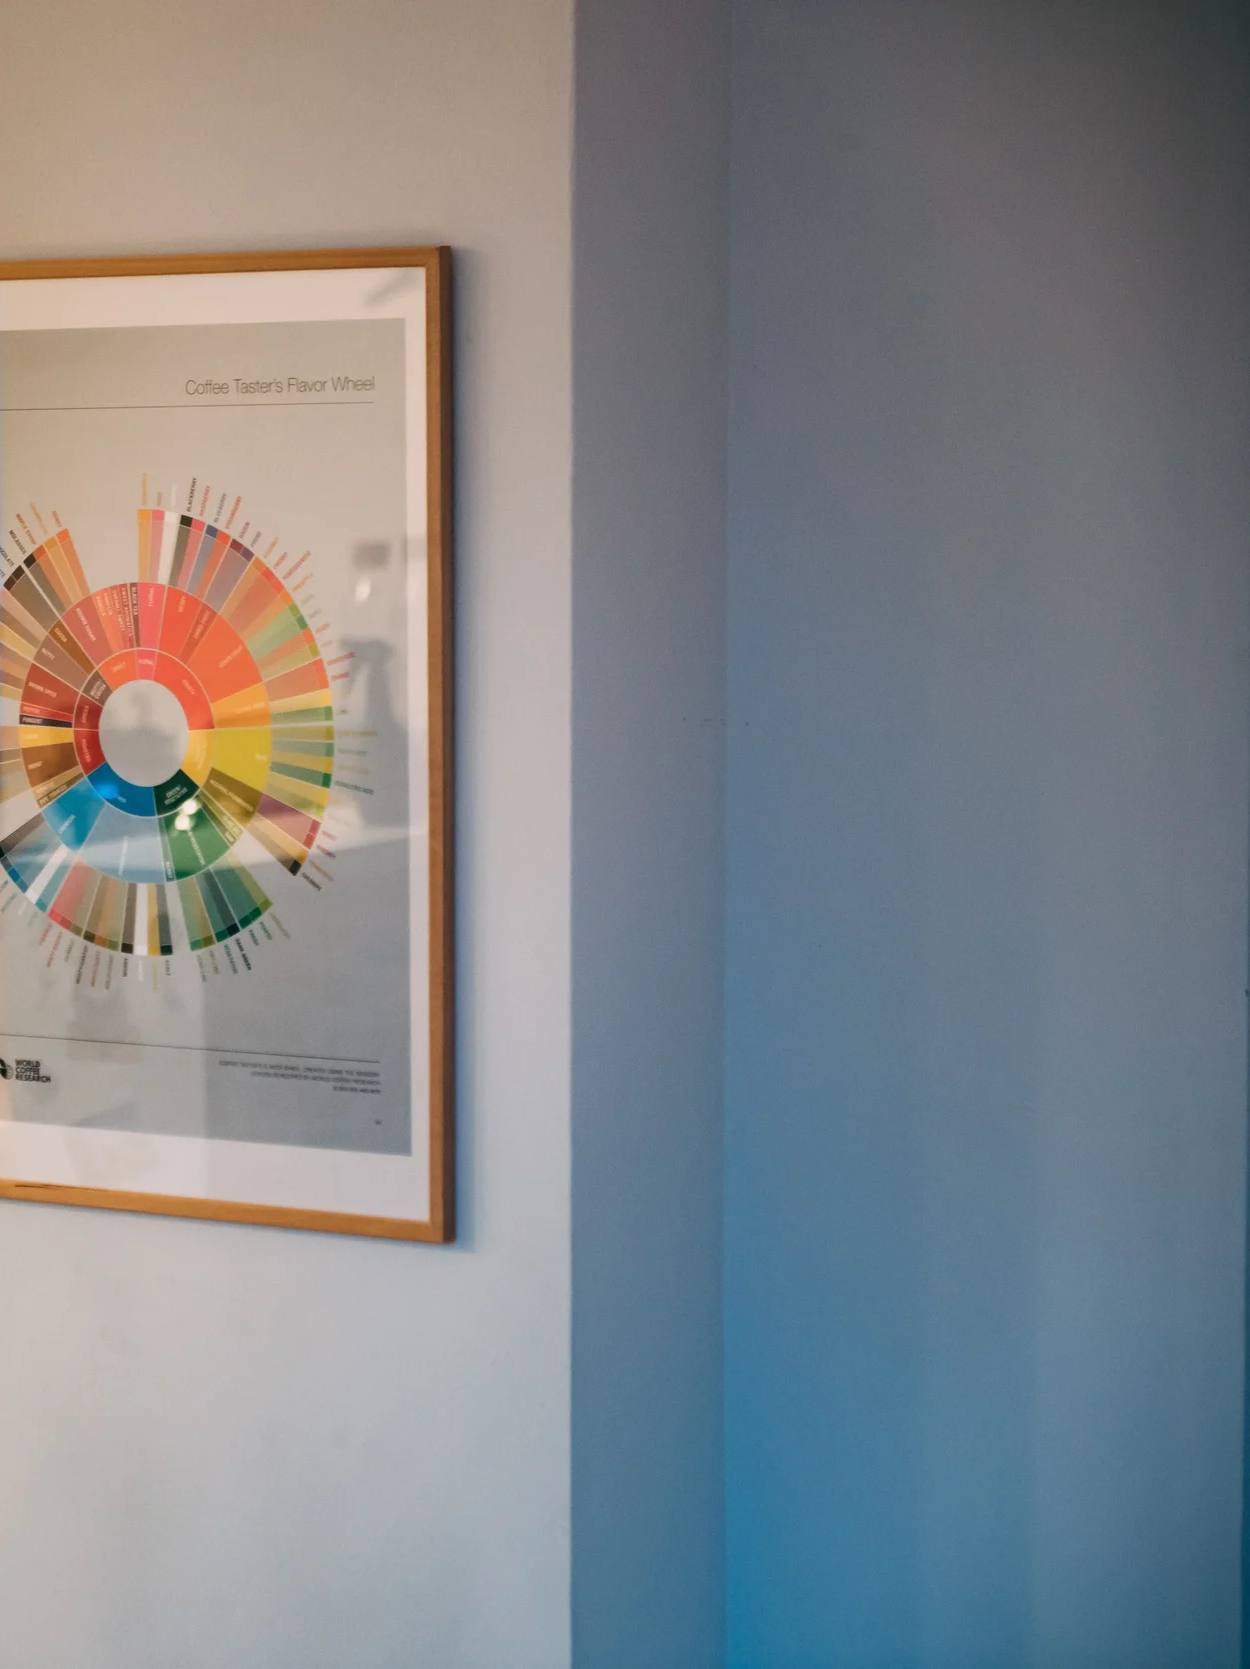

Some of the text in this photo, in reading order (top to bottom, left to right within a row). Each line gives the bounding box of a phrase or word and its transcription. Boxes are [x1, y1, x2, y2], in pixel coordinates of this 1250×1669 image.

[185, 375, 375, 396] Coffee Taster's Flavor Wheel
[15, 1060, 40, 1068] WORLD
[15, 1067, 40, 1075] COFFEE
[15, 1074, 51, 1083] RESEARCH
